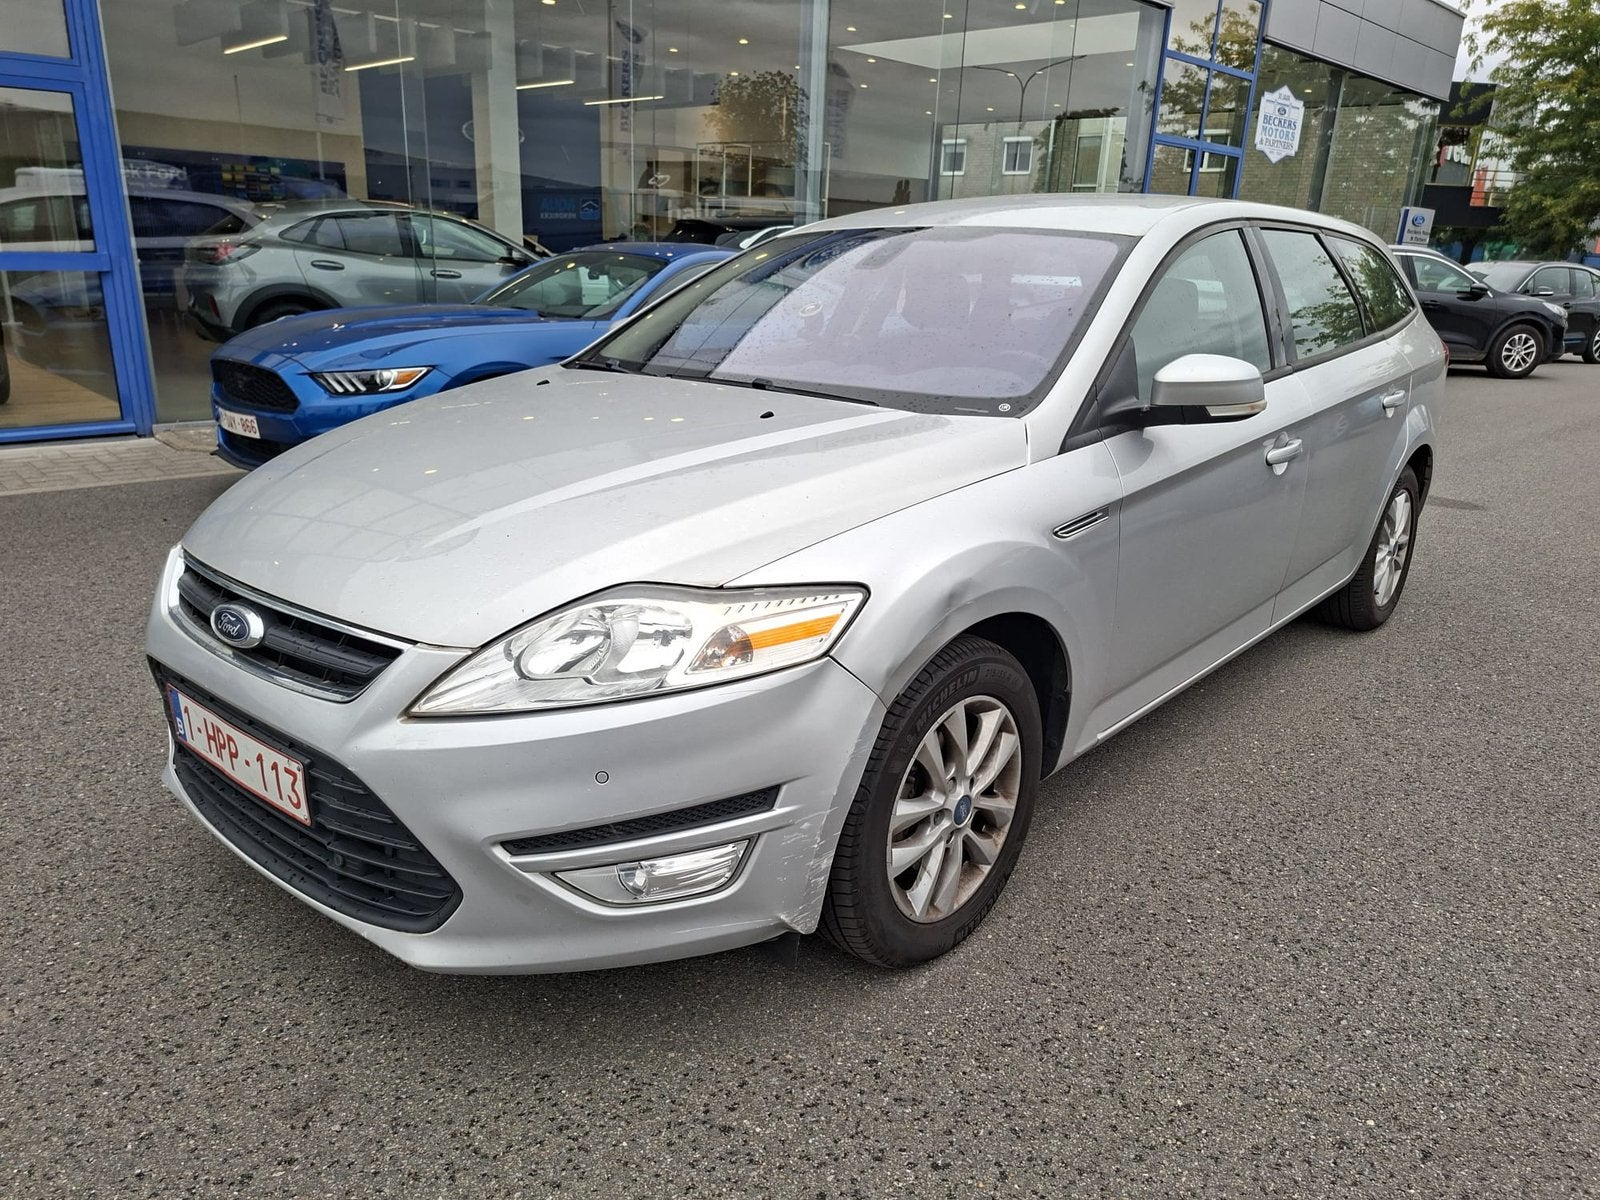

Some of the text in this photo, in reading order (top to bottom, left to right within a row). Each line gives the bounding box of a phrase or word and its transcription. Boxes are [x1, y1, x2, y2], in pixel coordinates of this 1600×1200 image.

[1262, 114, 1297, 131] BECKERS
[1261, 125, 1296, 142] MOTORS
[1264, 138, 1294, 150] PARTNERS
[217, 612, 241, 637] Ford
[183, 705, 301, 810] 1-HPP-113
